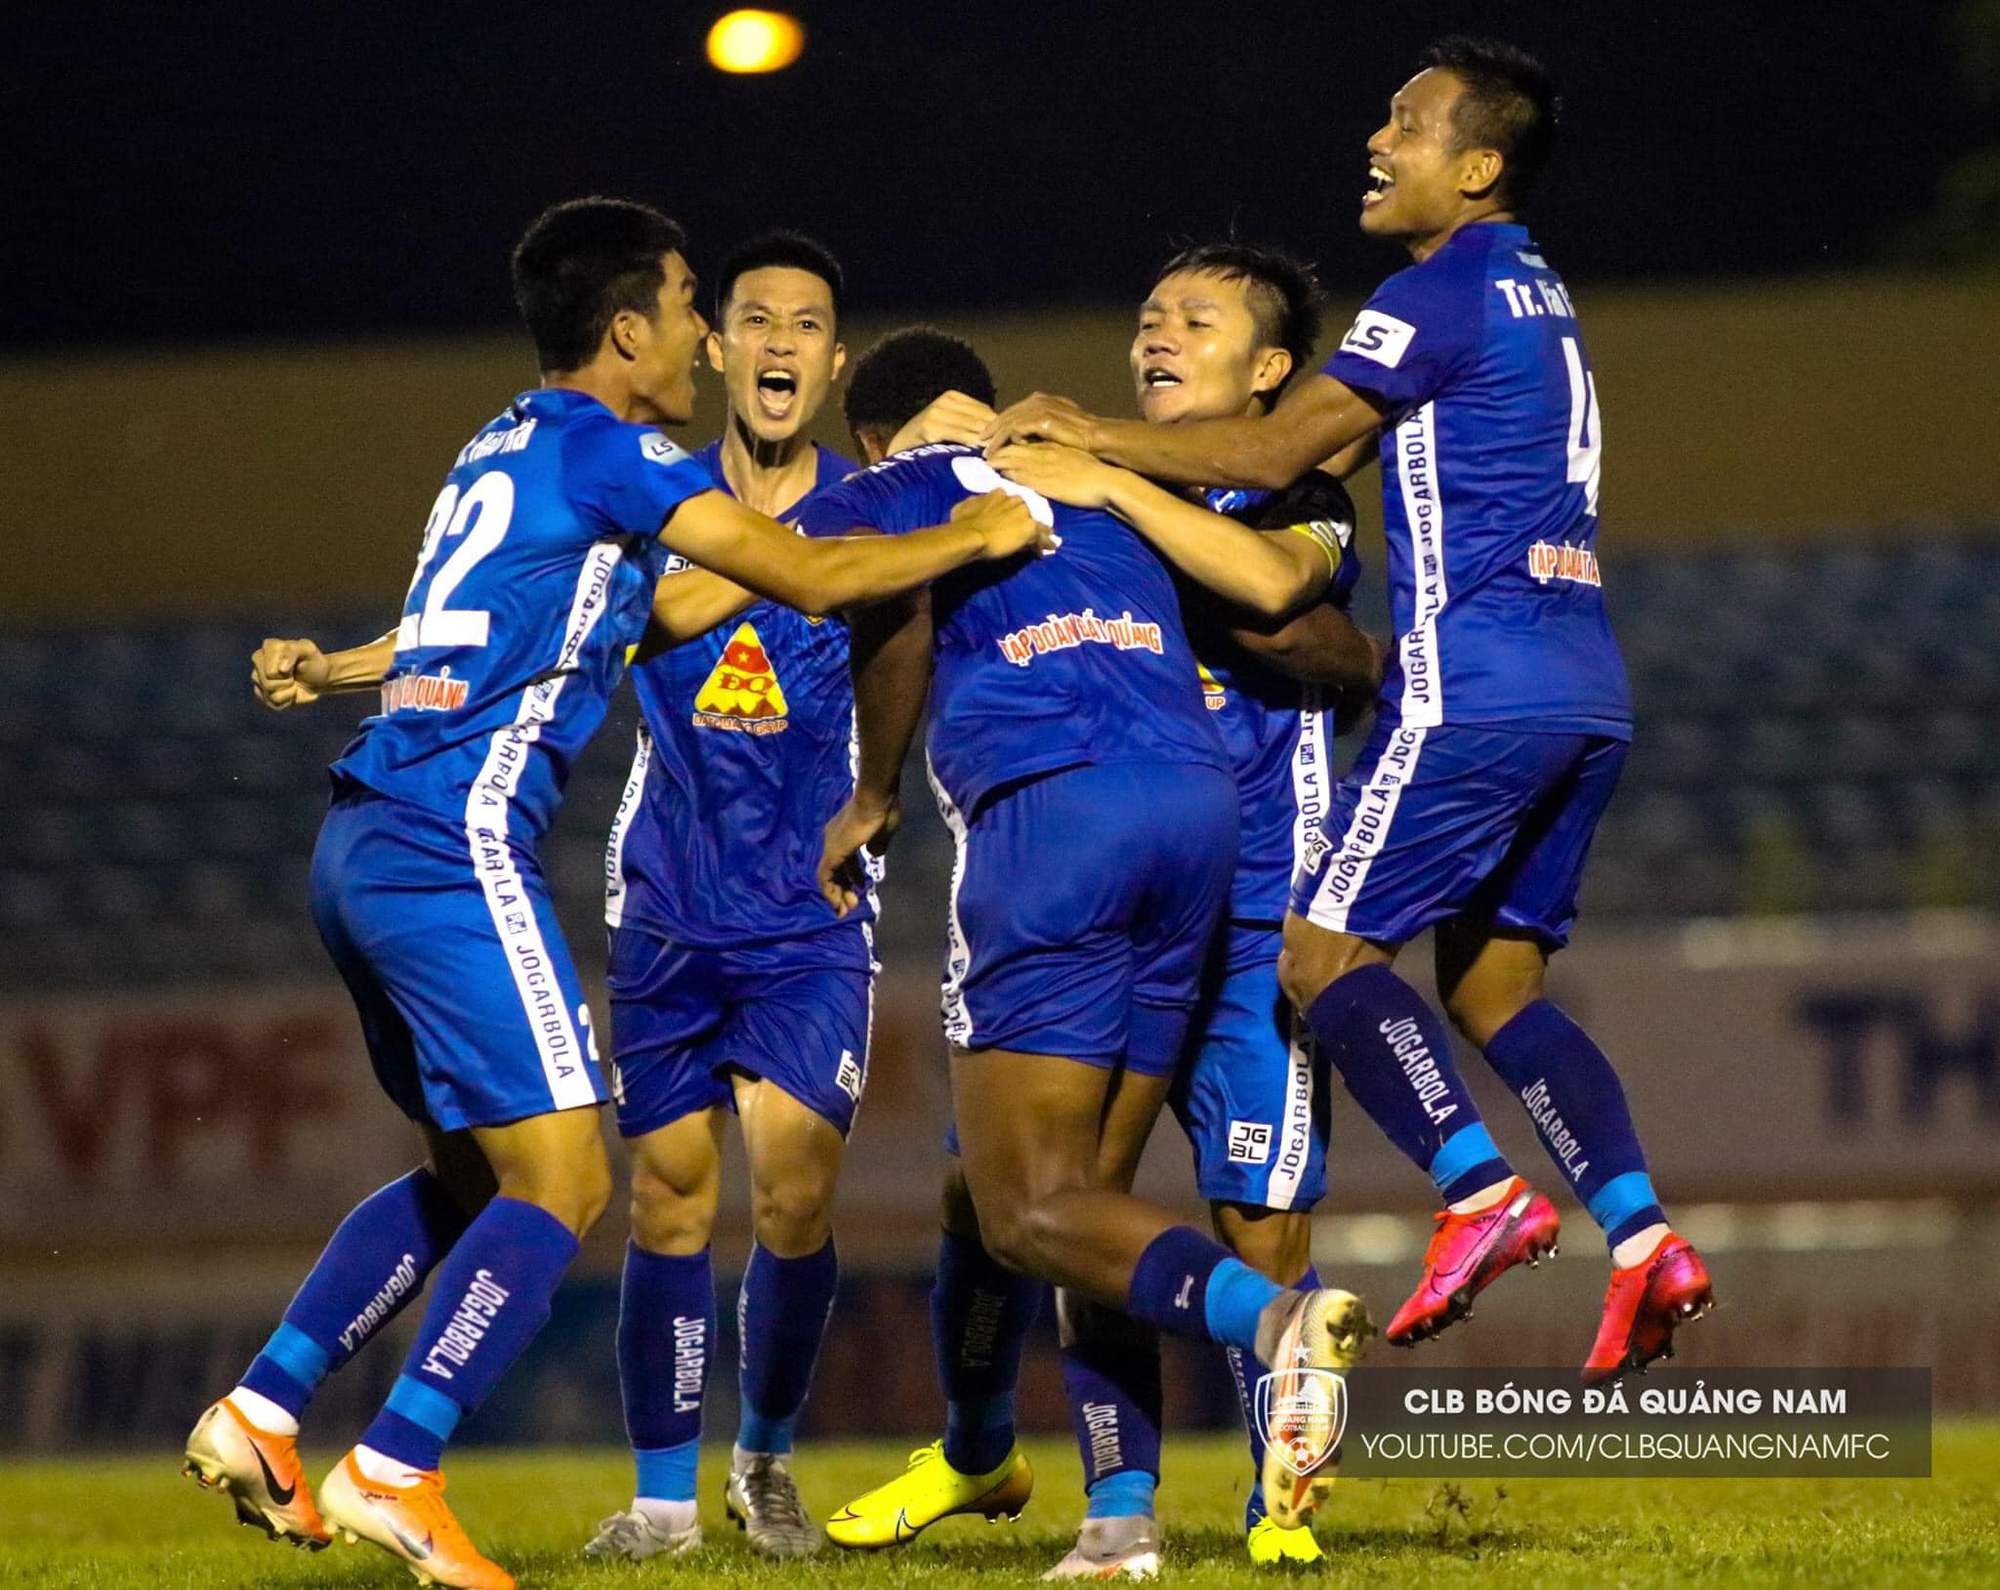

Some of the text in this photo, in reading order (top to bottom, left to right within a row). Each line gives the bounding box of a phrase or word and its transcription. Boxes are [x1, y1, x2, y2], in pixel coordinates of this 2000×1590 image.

[1345, 320, 1390, 351] LS
[1404, 408, 1435, 547] JOGARBOLA
[515, 944, 577, 1080] JOGARBOLA
[1378, 1015, 1460, 1127] JOGARBOLA
[1521, 1077, 1591, 1183] JOGARBOLA
[337, 1252, 417, 1353] JOGARBOLA
[420, 1267, 511, 1381] JOGARBOLA
[672, 1315, 707, 1414] JOGARBOLA
[1081, 1401, 1124, 1478] JOGARBOL
